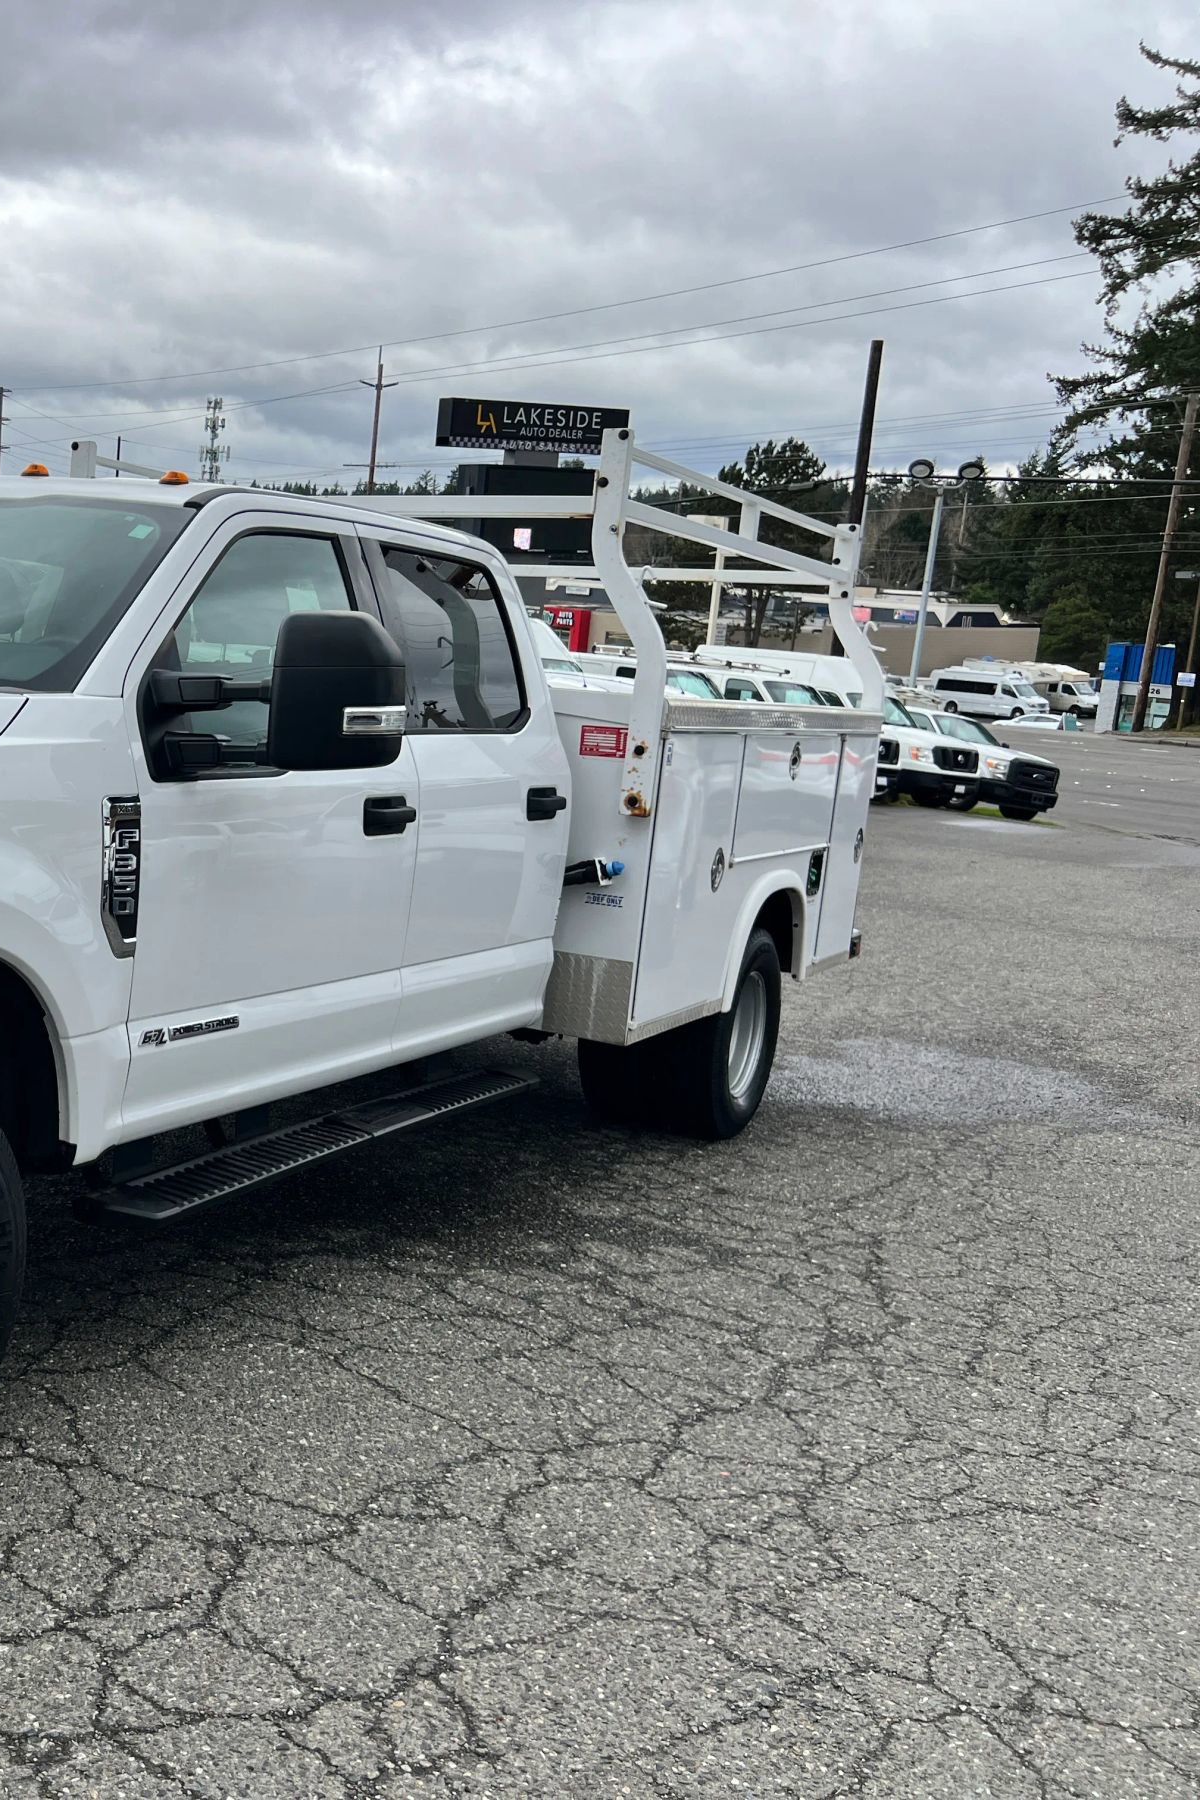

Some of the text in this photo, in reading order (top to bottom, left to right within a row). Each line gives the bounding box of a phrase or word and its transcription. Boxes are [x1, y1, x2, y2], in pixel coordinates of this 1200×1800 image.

[503, 406, 602, 429] LAKESIDE
[519, 427, 583, 439] AUTO DEALER
[500, 440, 577, 452] AUTO SALES
[592, 895, 622, 905] DEF ONLY
[172, 1022, 203, 1037] POWER
[204, 1015, 238, 1030] STROKE
